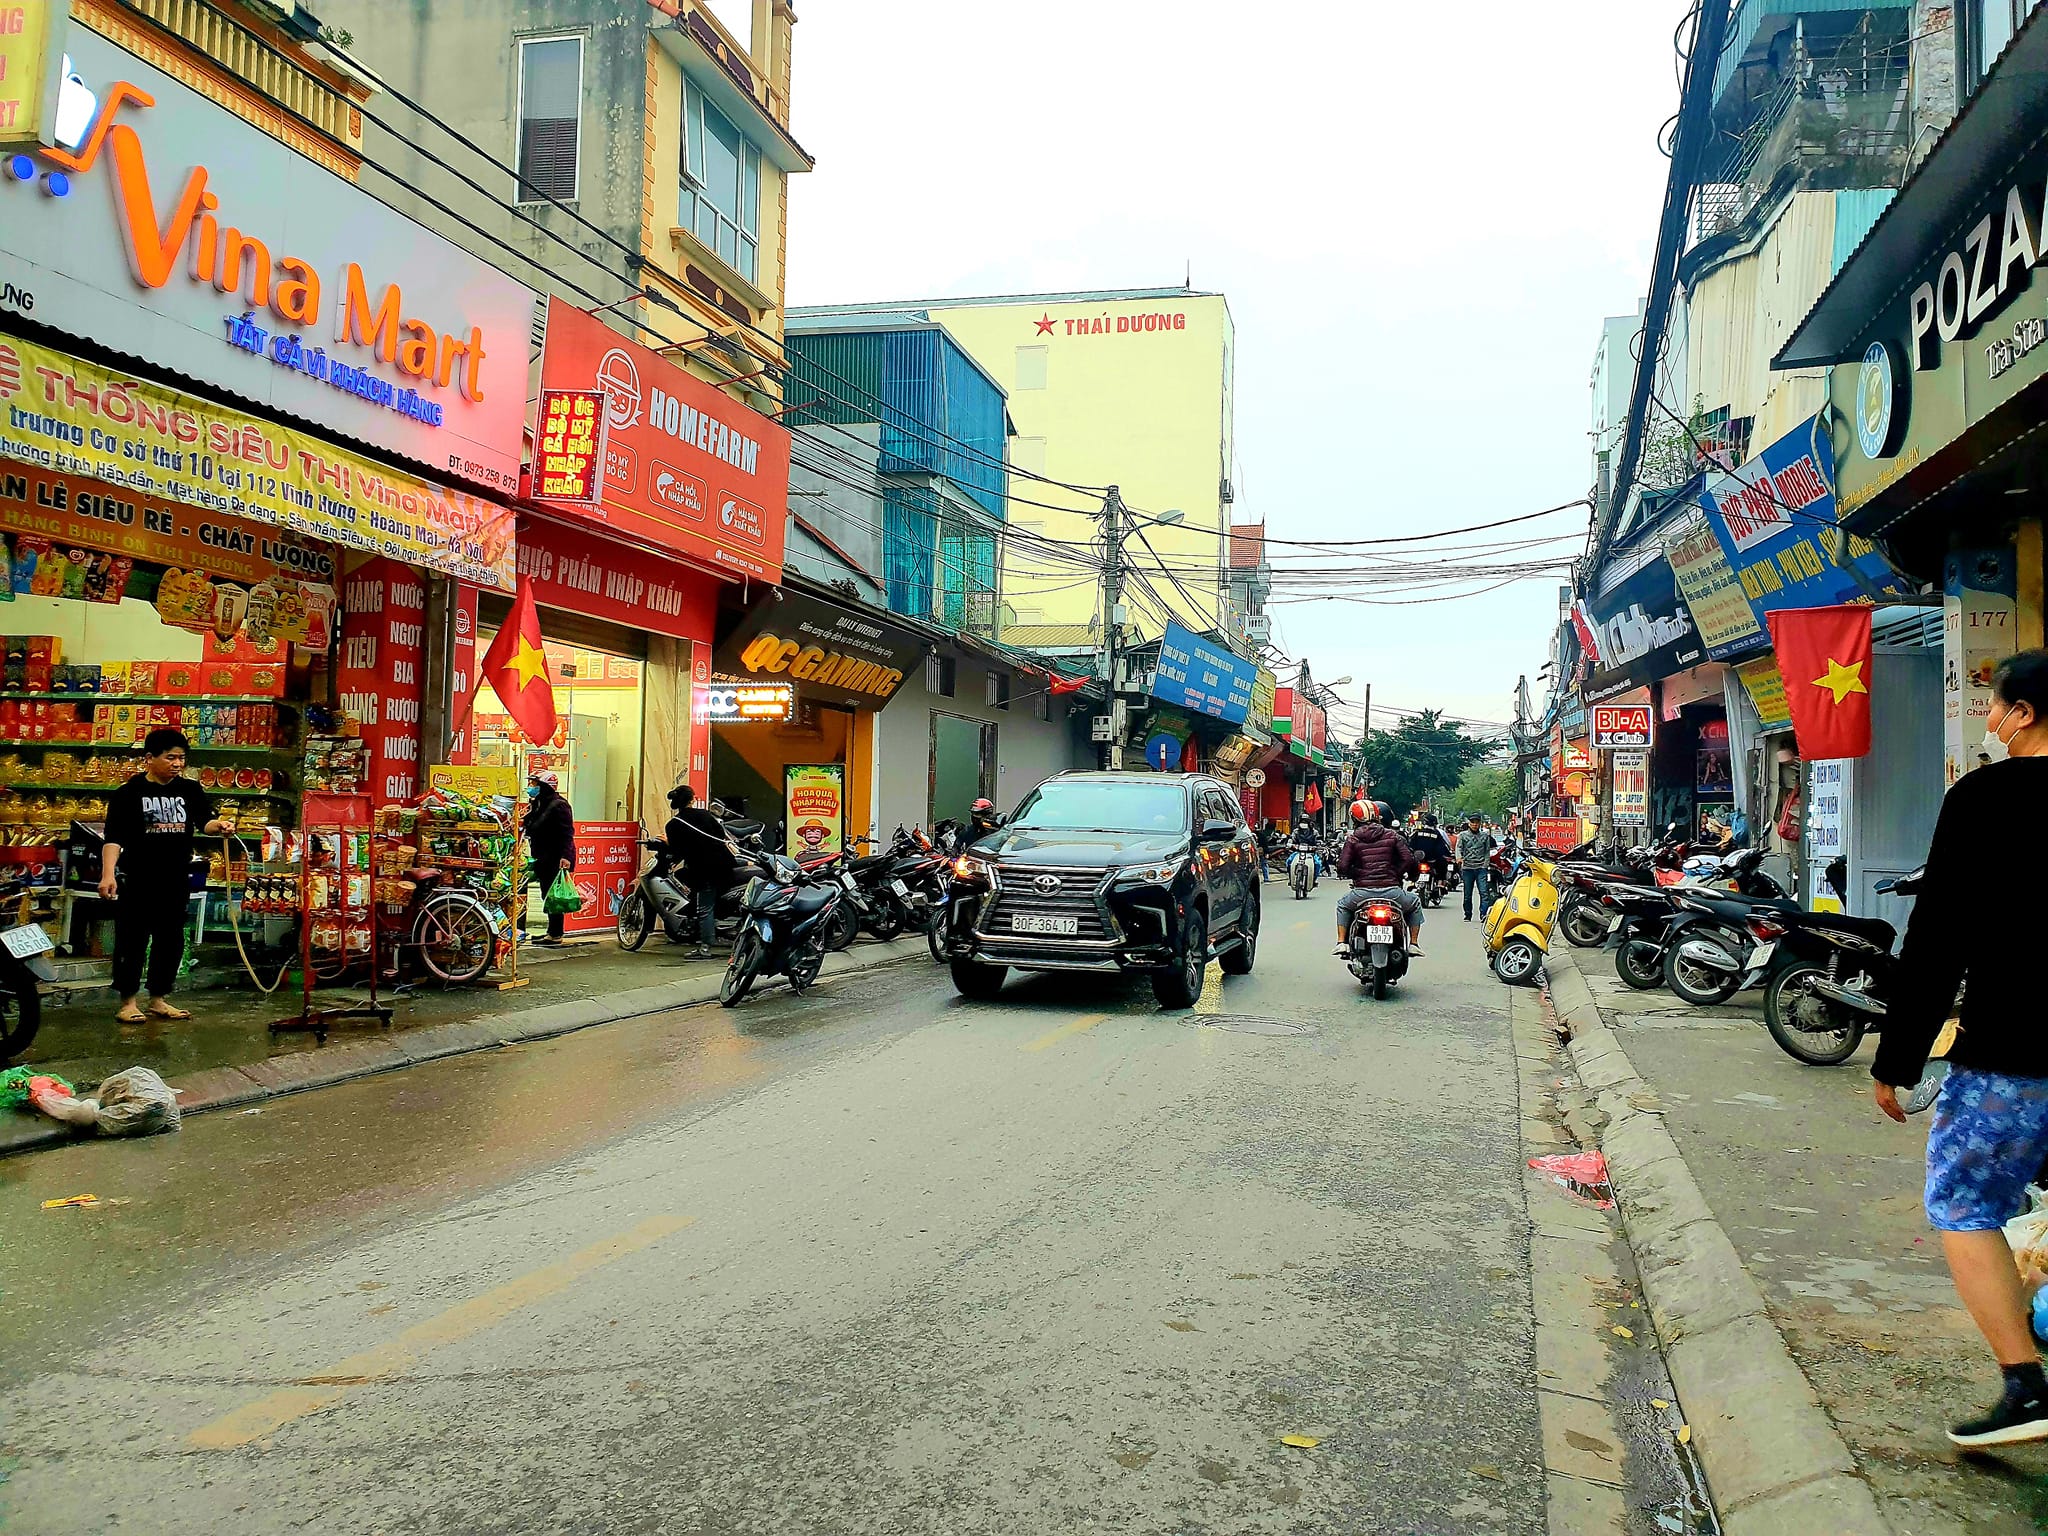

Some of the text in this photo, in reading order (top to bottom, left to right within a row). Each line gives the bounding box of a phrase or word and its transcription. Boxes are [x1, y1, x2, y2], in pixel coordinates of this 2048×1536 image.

[107, 125, 485, 402] Vina Mart
[1065, 312, 1185, 335] THÁI DƯƠNG
[1985, 318, 2045, 379] Trà Sữa
[229, 311, 268, 354] TẤT
[330, 366, 393, 406] KHÁCH
[396, 389, 445, 427] HÀNG
[650, 387, 758, 476] HOMEFARM
[36, 367, 200, 443] THỐNG
[209, 422, 289, 470] SIÊU
[299, 450, 351, 499] THỊ
[357, 472, 419, 513] Vina
[425, 502, 483, 535] Mart
[607, 450, 617, 462] BÒ
[449, 454, 462, 472] ĐT:
[464, 460, 485, 478] 0973
[502, 474, 517, 490] 873
[606, 463, 628, 481] BÒ ÚC
[675, 479, 685, 493] CÁ
[1773, 454, 1827, 509] MOBILE
[189, 452, 213, 480] 10
[218, 465, 241, 493] tại
[247, 473, 276, 497] 112
[370, 511, 411, 542] Hoàng
[415, 524, 438, 547] Mai
[230, 496, 246, 513] Đa
[5, 508, 62, 534] HÀNG
[37, 480, 68, 510] LẺ
[75, 489, 134, 525] SIÊU
[144, 508, 173, 536] RẺ
[198, 519, 254, 556] CHẤT
[262, 538, 334, 577] LƯỢNG
[345, 574, 383, 613] HÀNG
[517, 543, 682, 617] HỰC PHẨM NHẬP KHẨU
[391, 582, 425, 610] NƯỚC
[1968, 611, 2008, 627] 177
[346, 630, 376, 669] TIÊU
[390, 621, 423, 651] NGỌT
[394, 661, 414, 685] BIA
[386, 698, 419, 727] RƯỢU
[1597, 710, 1648, 730] BI-A
[384, 732, 418, 762] NƯỚC
[1600, 732, 1645, 744] X Club
[386, 771, 414, 803] GIẶT
[1615, 766, 1629, 792] MÁY
[797, 790, 815, 798] HOA
[142, 797, 187, 823] PARIS
[1014, 917, 1077, 934] 30F-364.12
[11, 938, 50, 958] 095.09
